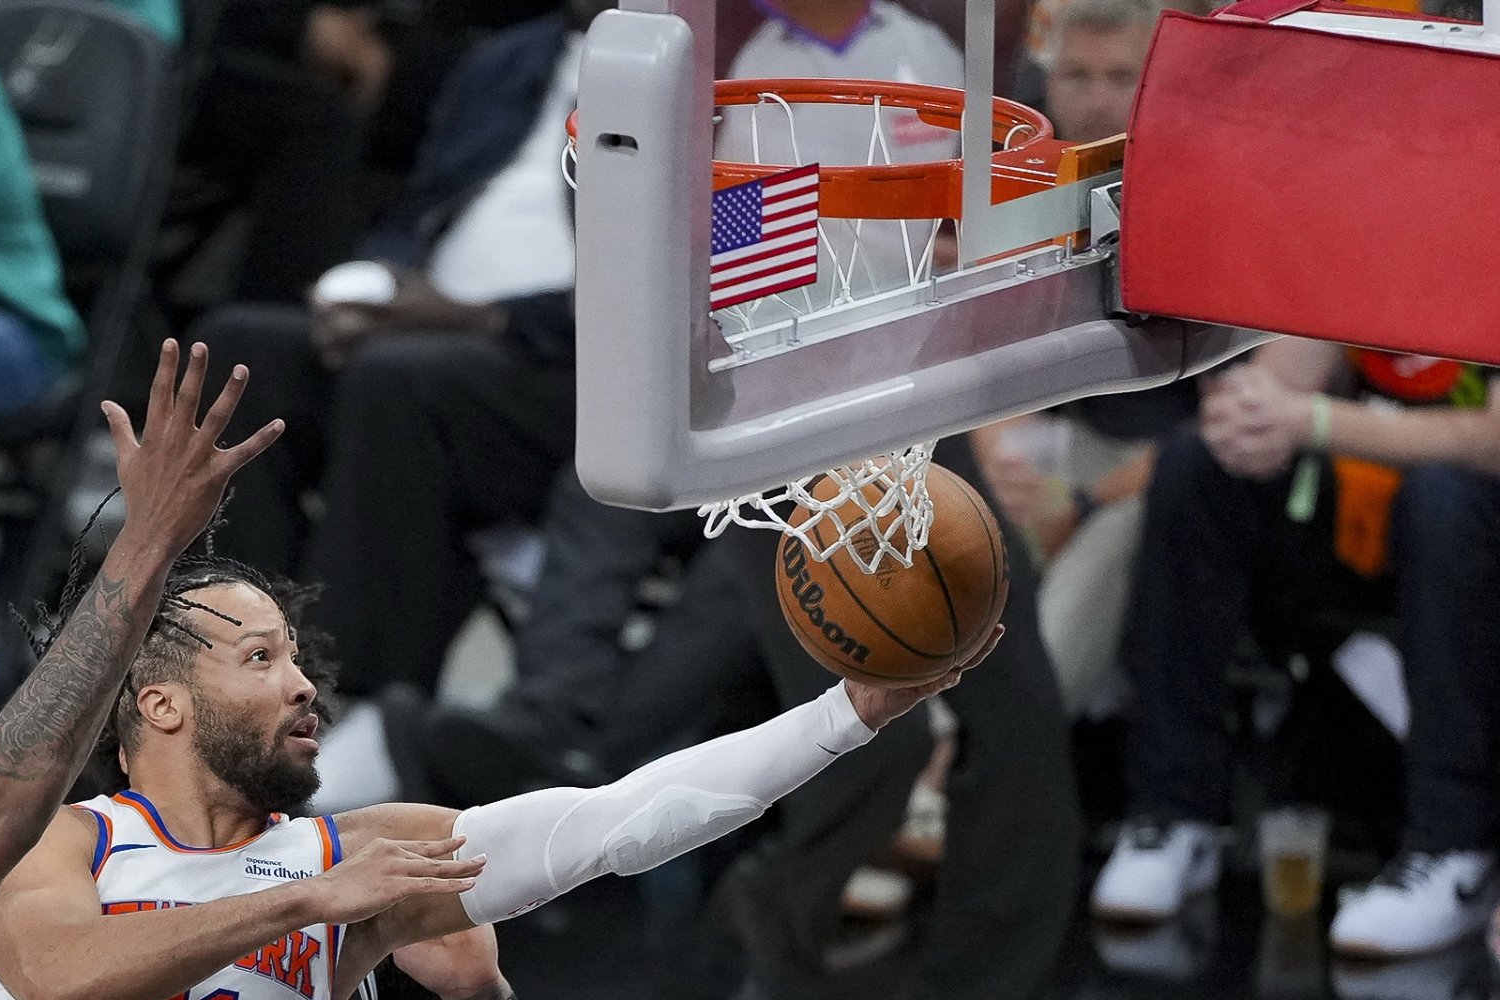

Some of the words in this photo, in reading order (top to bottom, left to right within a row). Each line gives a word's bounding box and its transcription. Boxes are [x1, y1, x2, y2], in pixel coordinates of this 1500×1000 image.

[784, 535, 872, 665] Wilson
[245, 864, 272, 877] abu
[273, 867, 314, 880] dhabi
[233, 931, 322, 1000] RK
